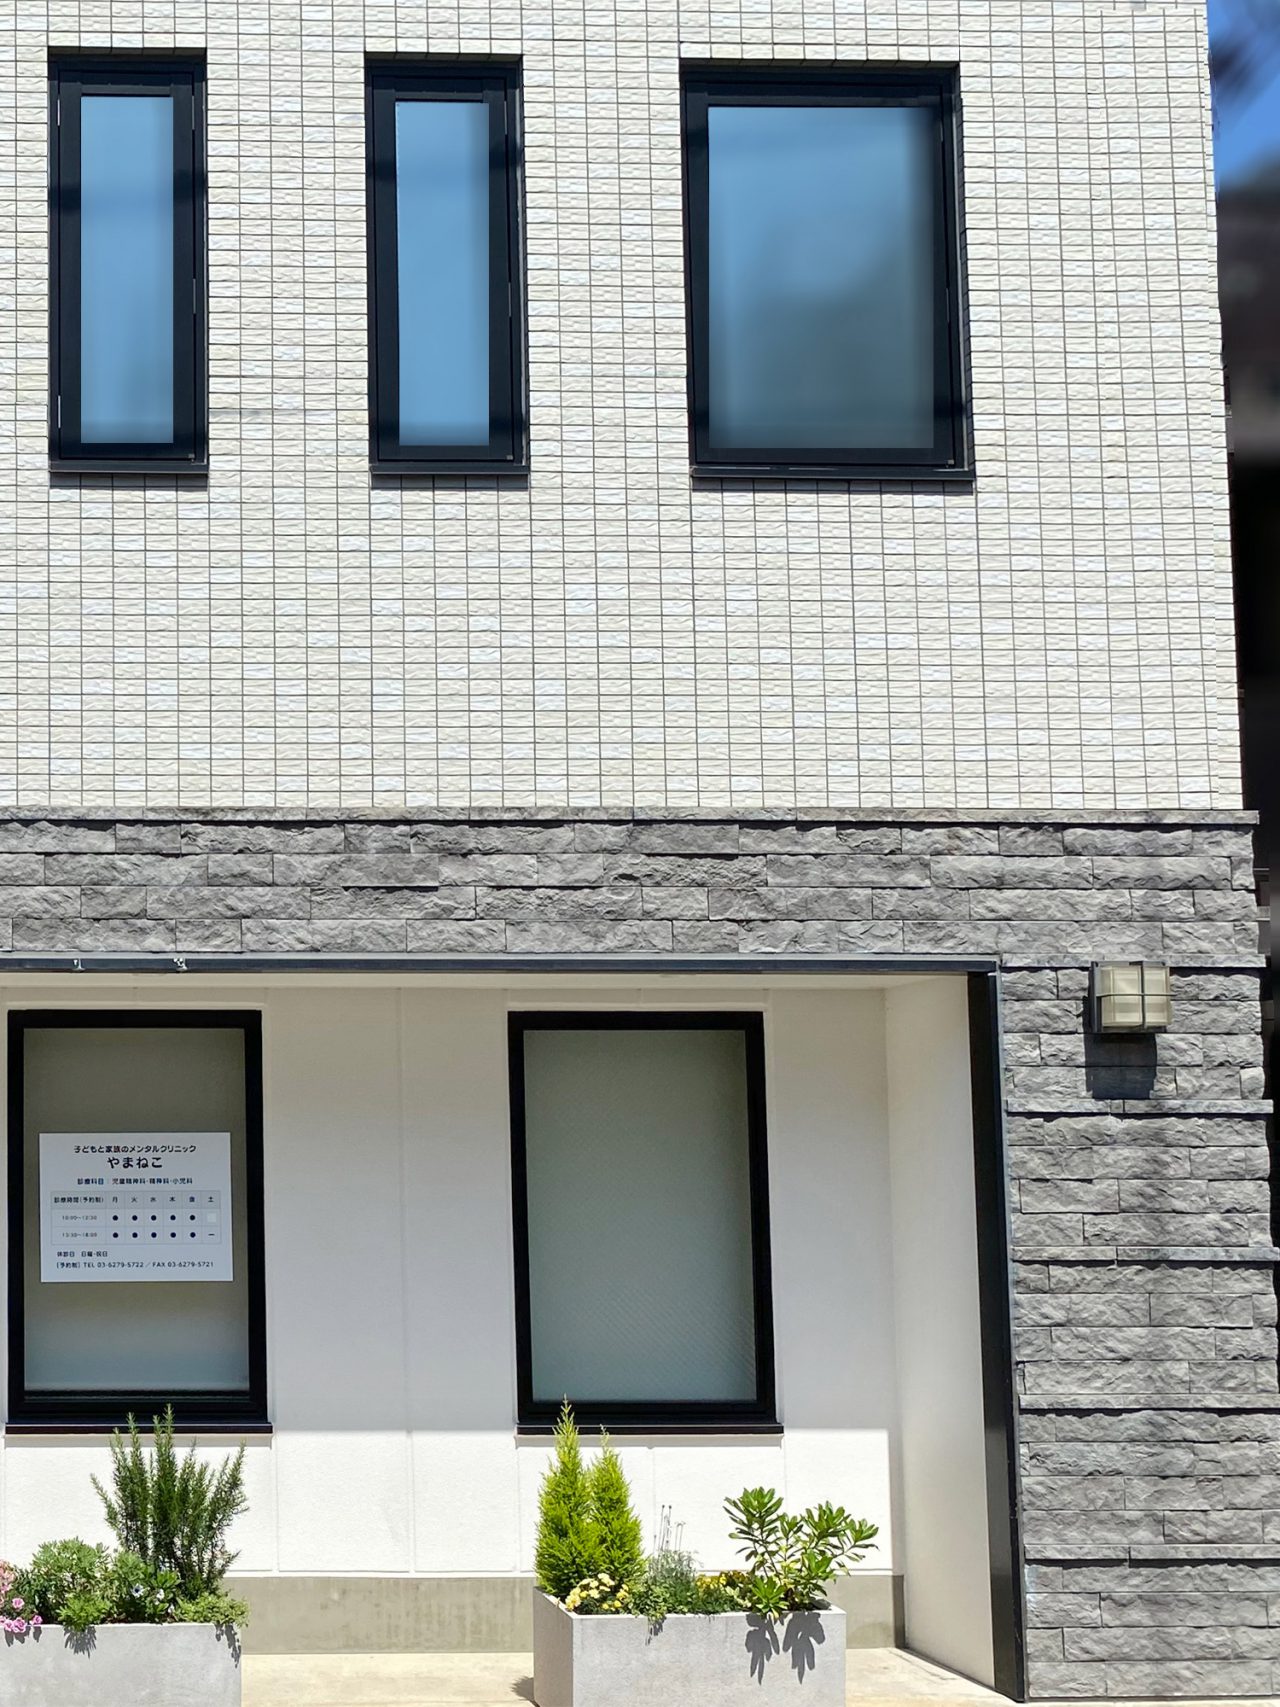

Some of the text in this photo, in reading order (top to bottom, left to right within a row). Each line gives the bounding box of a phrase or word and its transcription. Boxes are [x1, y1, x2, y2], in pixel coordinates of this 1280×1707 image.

[74, 1145, 197, 1154] 子どもと家族のメンタルクリニック
[107, 1156, 163, 1169] やまねこ
